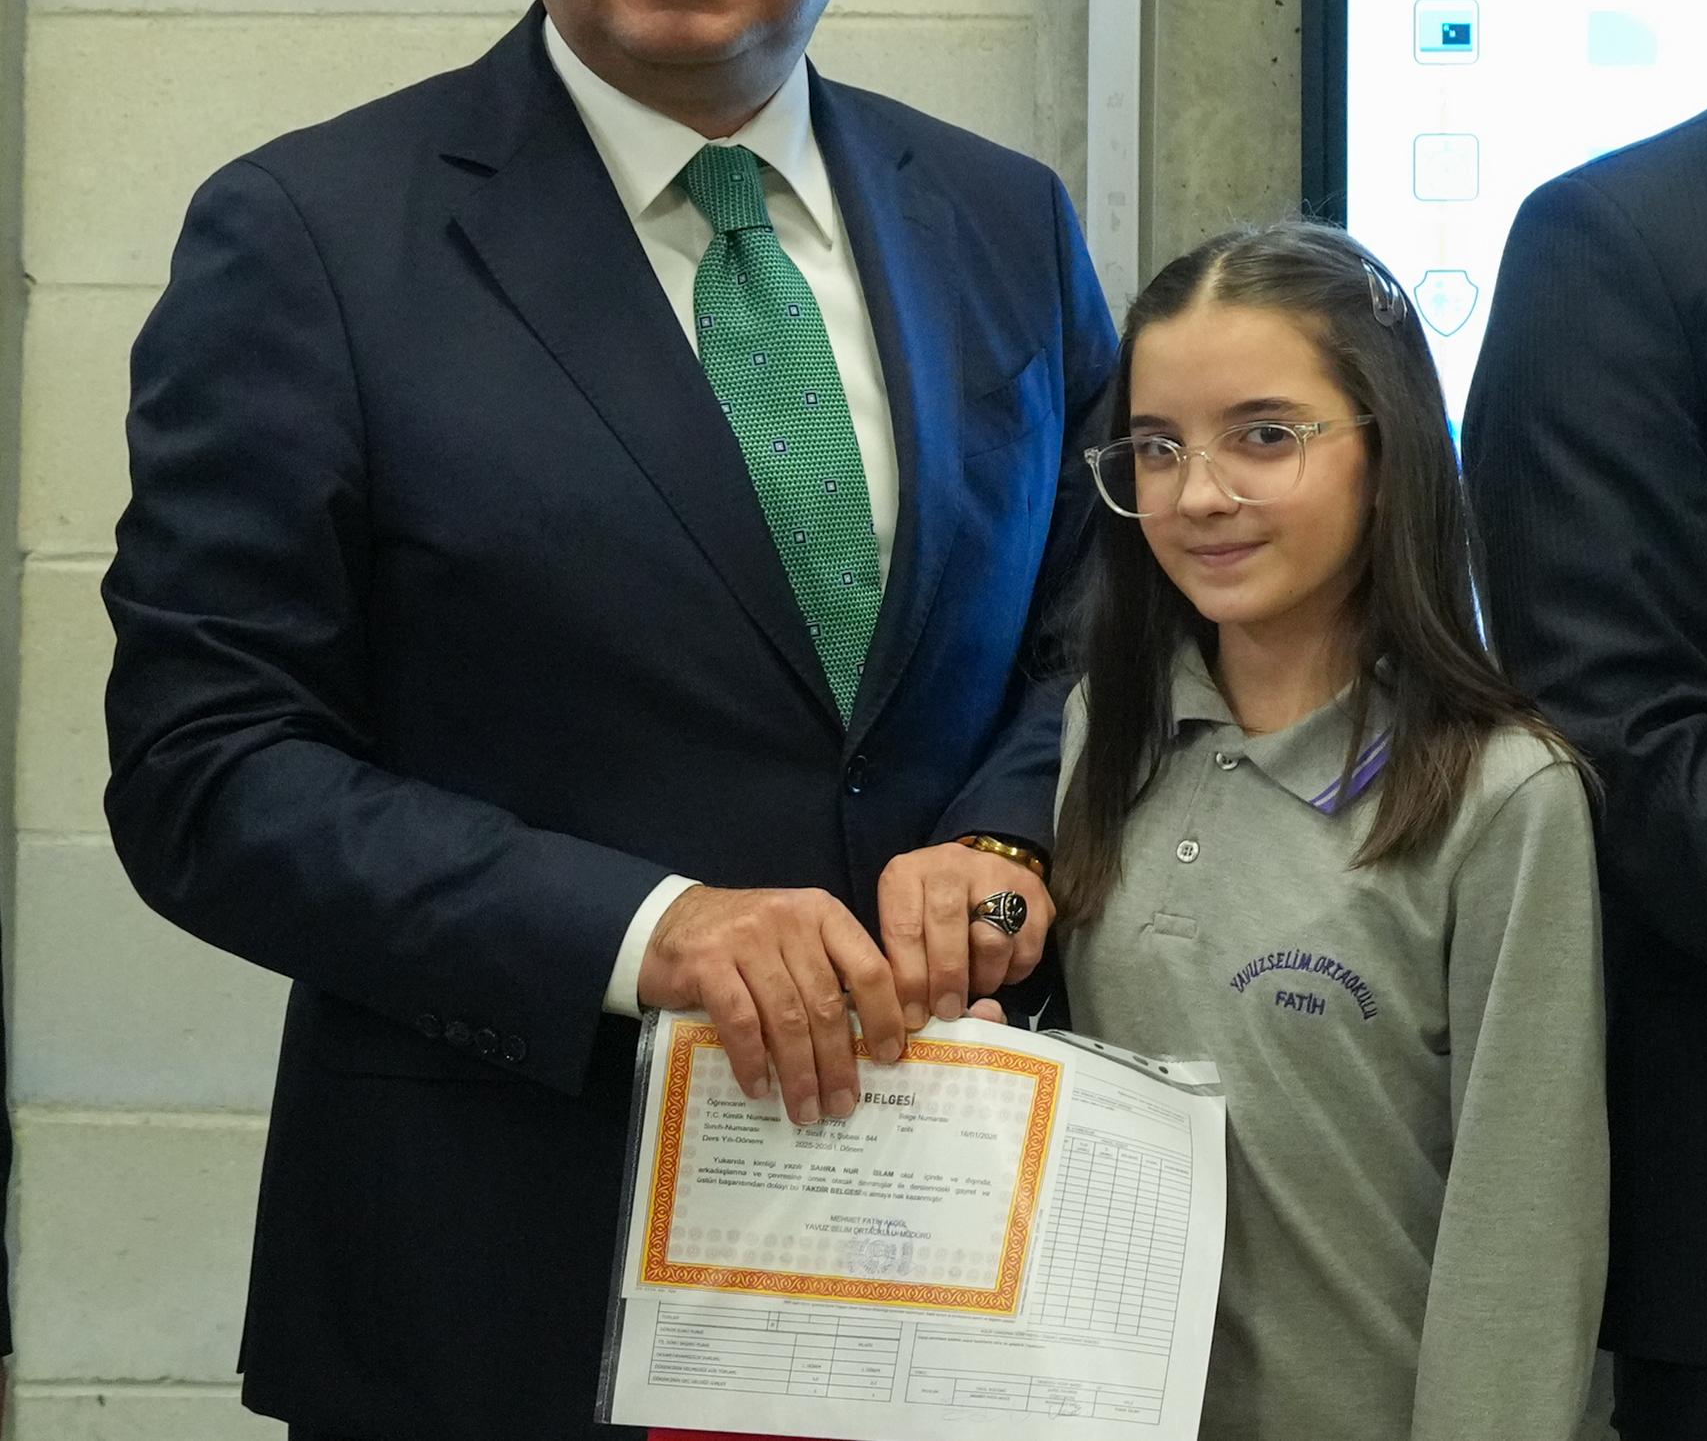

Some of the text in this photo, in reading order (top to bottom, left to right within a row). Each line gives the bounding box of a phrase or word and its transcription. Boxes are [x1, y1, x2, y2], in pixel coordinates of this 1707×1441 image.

[1275, 990, 1326, 1015] FATİH
[865, 1092, 916, 1107] BELGESİ
[843, 1167, 859, 1175] NUR
[801, 1184, 829, 1194] TAKDİR
[805, 1222, 829, 1231] YAVUZ
